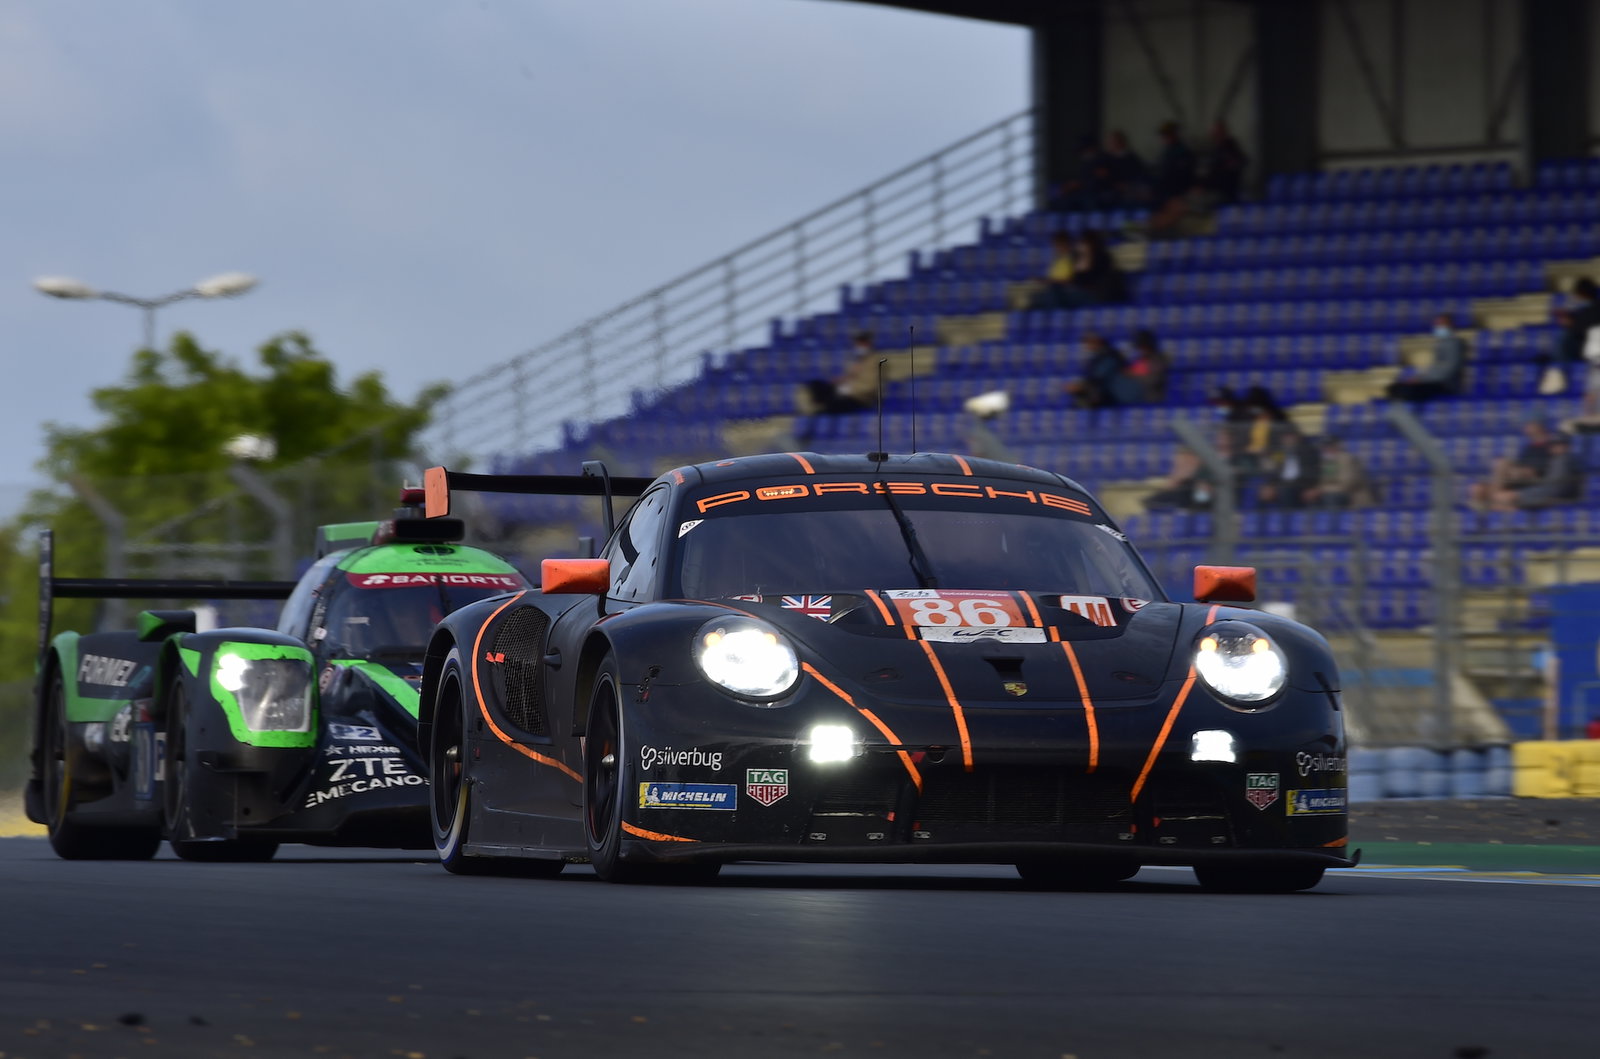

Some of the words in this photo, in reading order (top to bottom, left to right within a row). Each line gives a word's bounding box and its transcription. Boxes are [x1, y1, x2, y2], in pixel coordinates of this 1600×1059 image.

[696, 482, 1092, 516] PORSCHE
[392, 575, 516, 587] BANORTE
[909, 599, 1011, 627] 86
[656, 747, 723, 771] silverbug
[328, 757, 408, 782] ZTE
[751, 771, 785, 783] TAG
[1249, 776, 1277, 786] TAG
[661, 791, 727, 802] MICHELIN
[748, 784, 787, 803] HEUER
